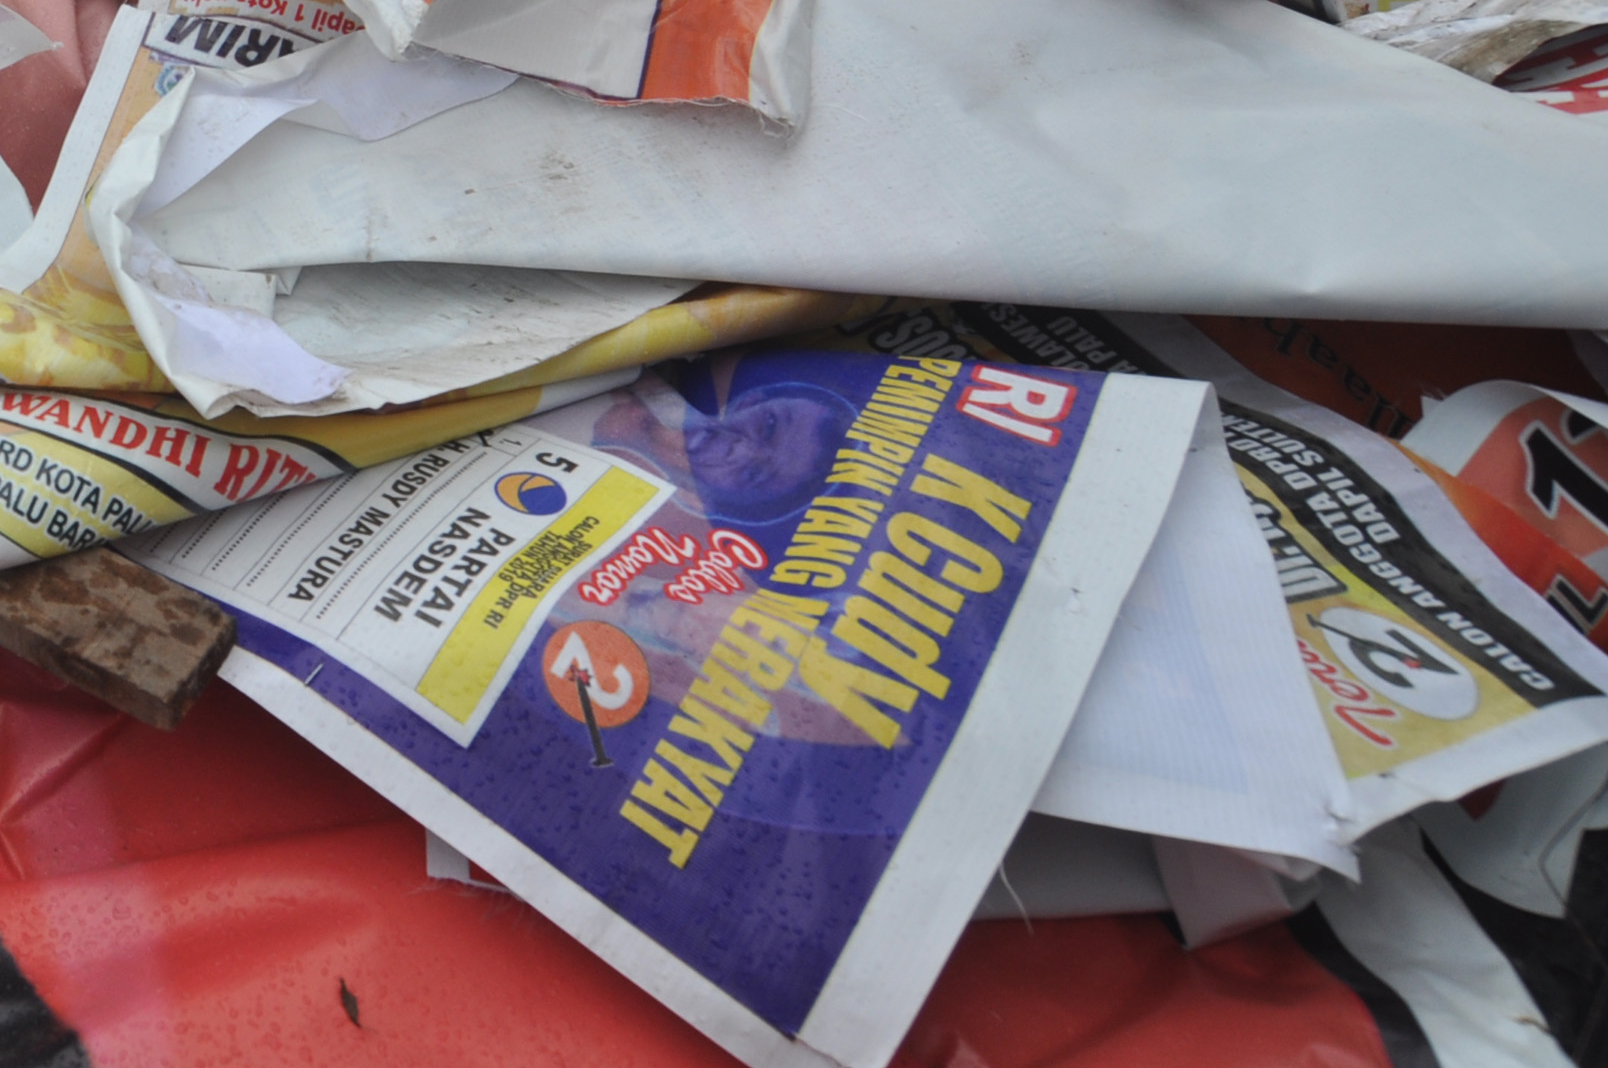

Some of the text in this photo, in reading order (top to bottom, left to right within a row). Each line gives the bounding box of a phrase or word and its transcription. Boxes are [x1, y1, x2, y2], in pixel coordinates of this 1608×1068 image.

[294, 2, 306, 21] 1
[310, 8, 365, 36] apil
[825, 355, 963, 496] PEMIMPIN
[955, 363, 1078, 446] RI
[34, 458, 100, 512] KOTA
[381, 448, 453, 509] RUSDY
[534, 451, 579, 474] 5
[769, 489, 886, 590] YANG
[1316, 469, 1400, 545] DAPIL
[287, 504, 384, 603] MASTURA
[373, 507, 491, 624] NASDEM
[414, 528, 516, 629] PARTAI
[578, 527, 702, 607] Nomor
[669, 528, 768, 605] Coblos
[1305, 491, 1447, 609] ANGGOTA
[551, 630, 635, 711] 2
[799, 510, 1005, 750] Cudy
[1438, 610, 1556, 692] CALON
[619, 587, 830, 869] MERAKYAT
